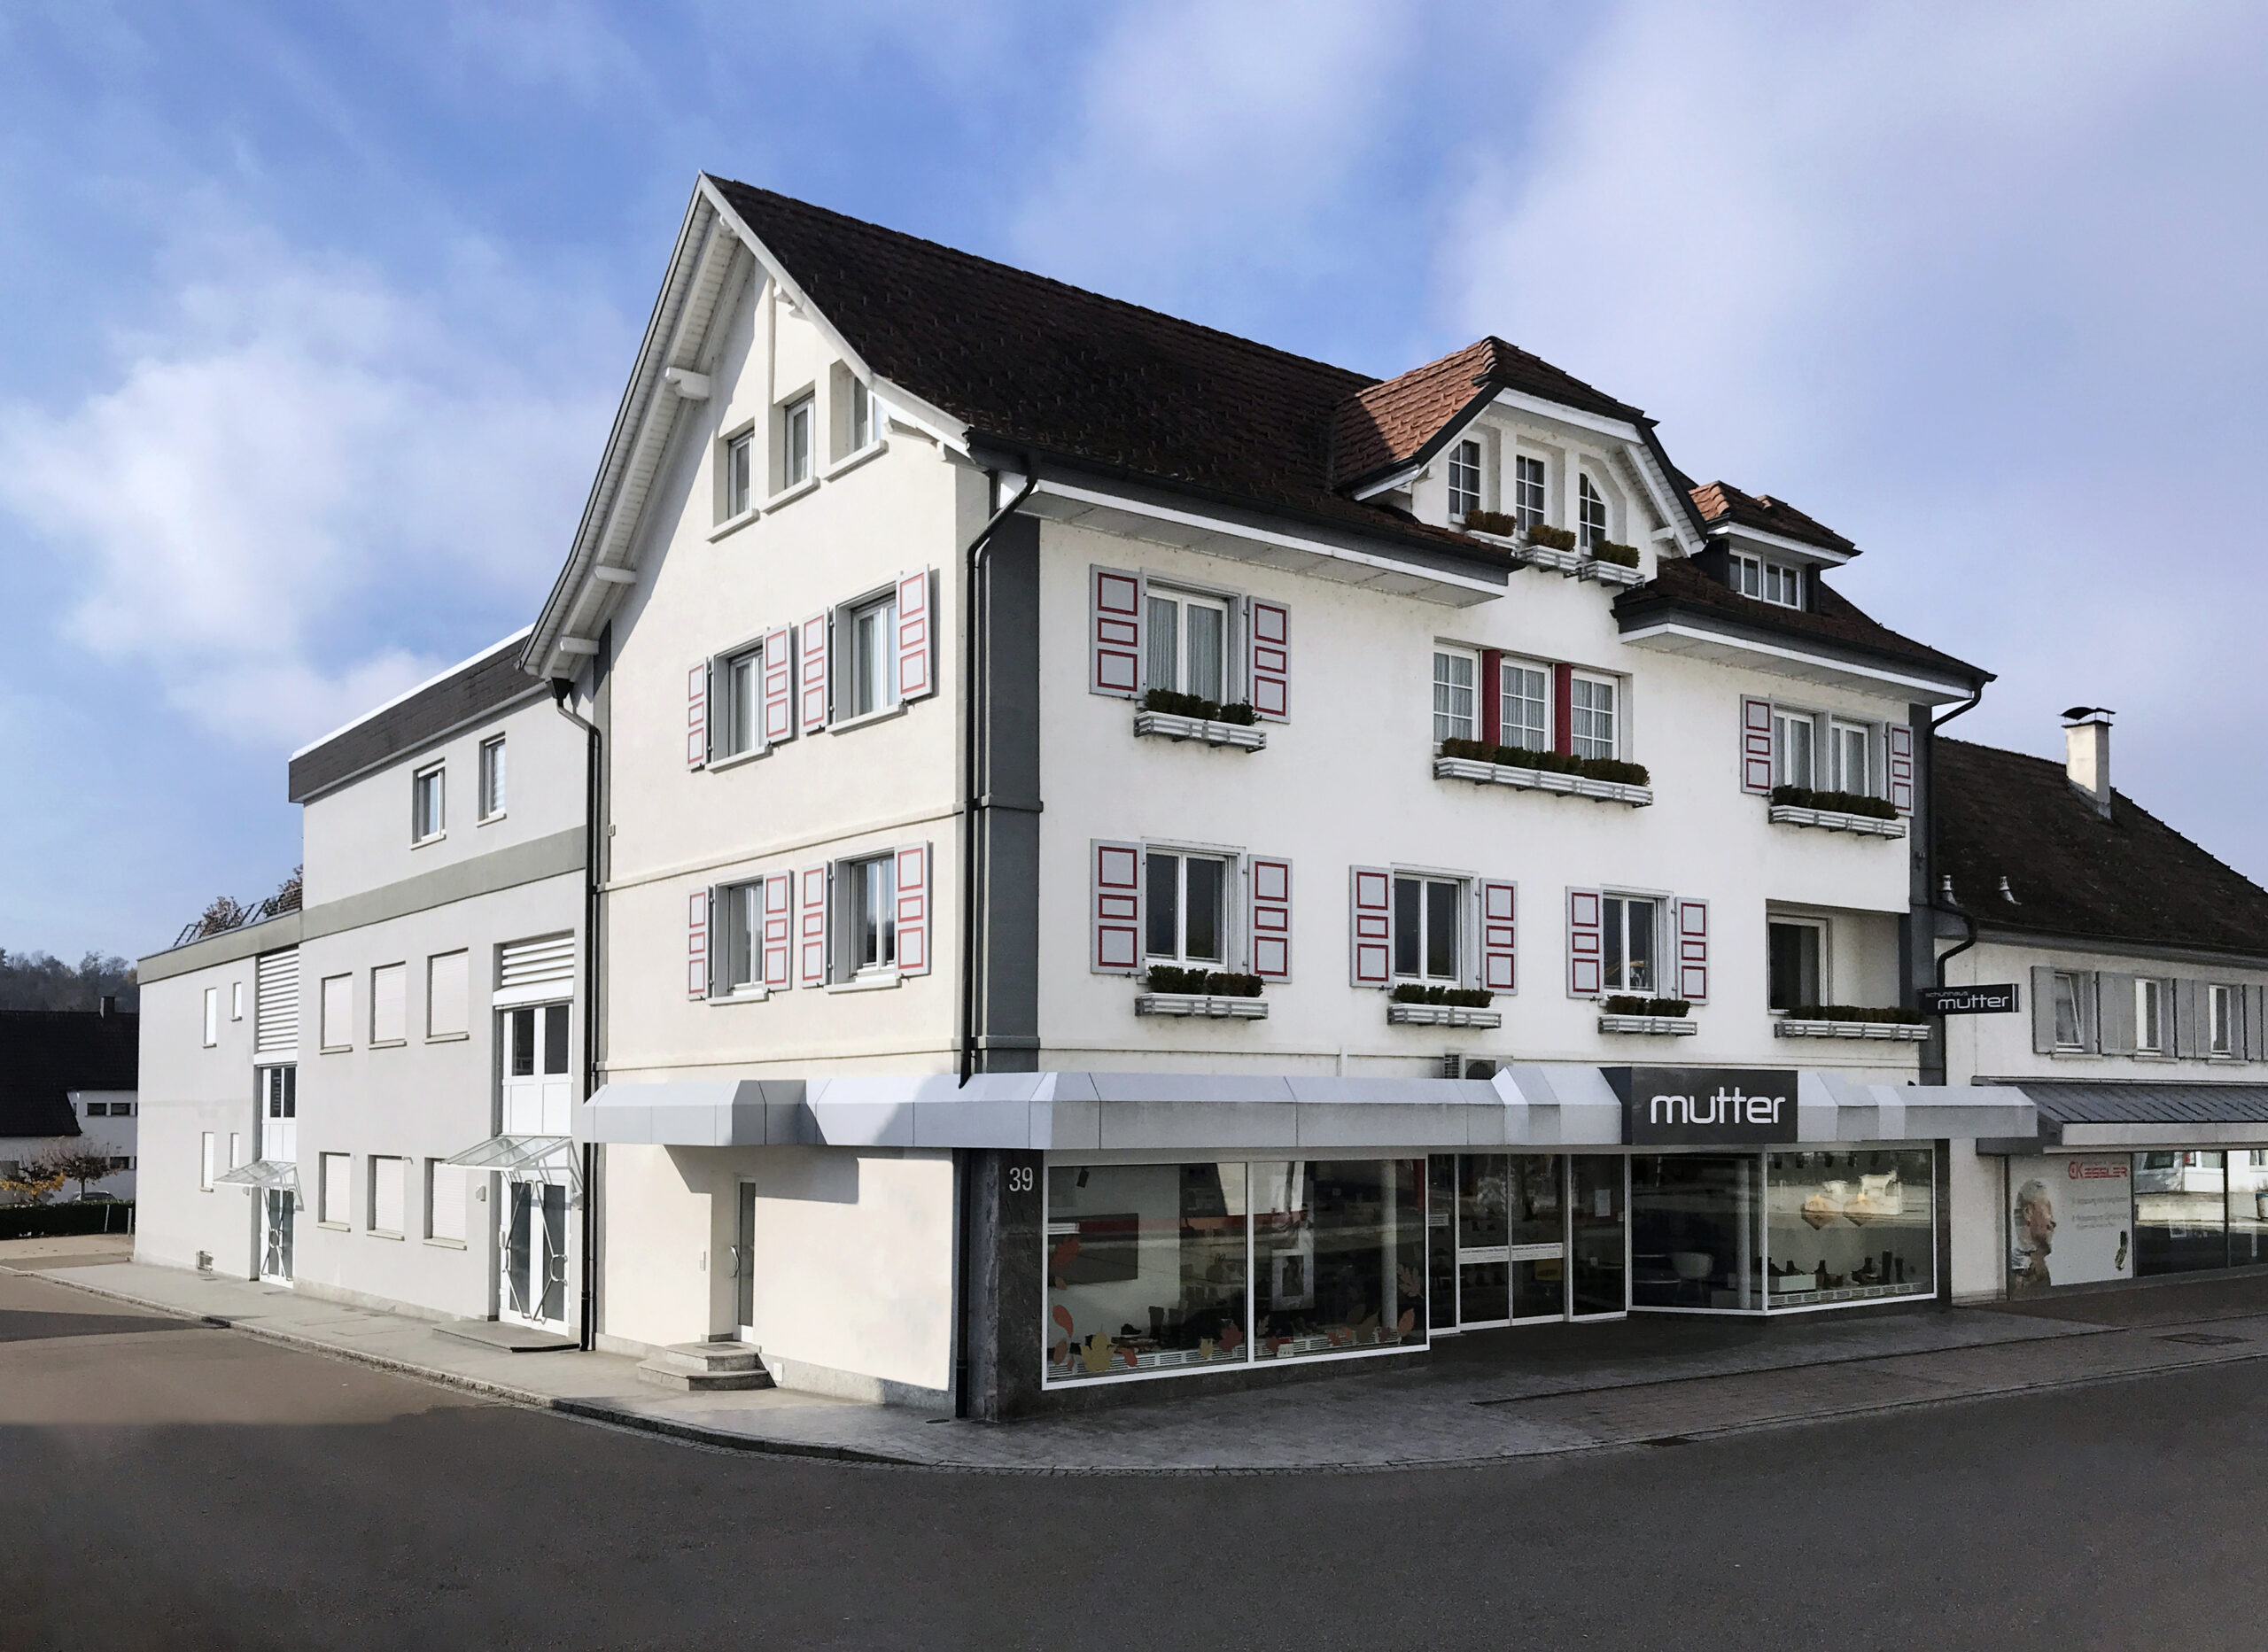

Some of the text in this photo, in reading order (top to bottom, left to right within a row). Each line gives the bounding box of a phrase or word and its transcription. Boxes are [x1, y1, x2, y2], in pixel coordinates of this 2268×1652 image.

[1938, 994, 2009, 1010] mutter
[1651, 1087, 1786, 1124] mutter
[1009, 1167, 1033, 1191] 39
